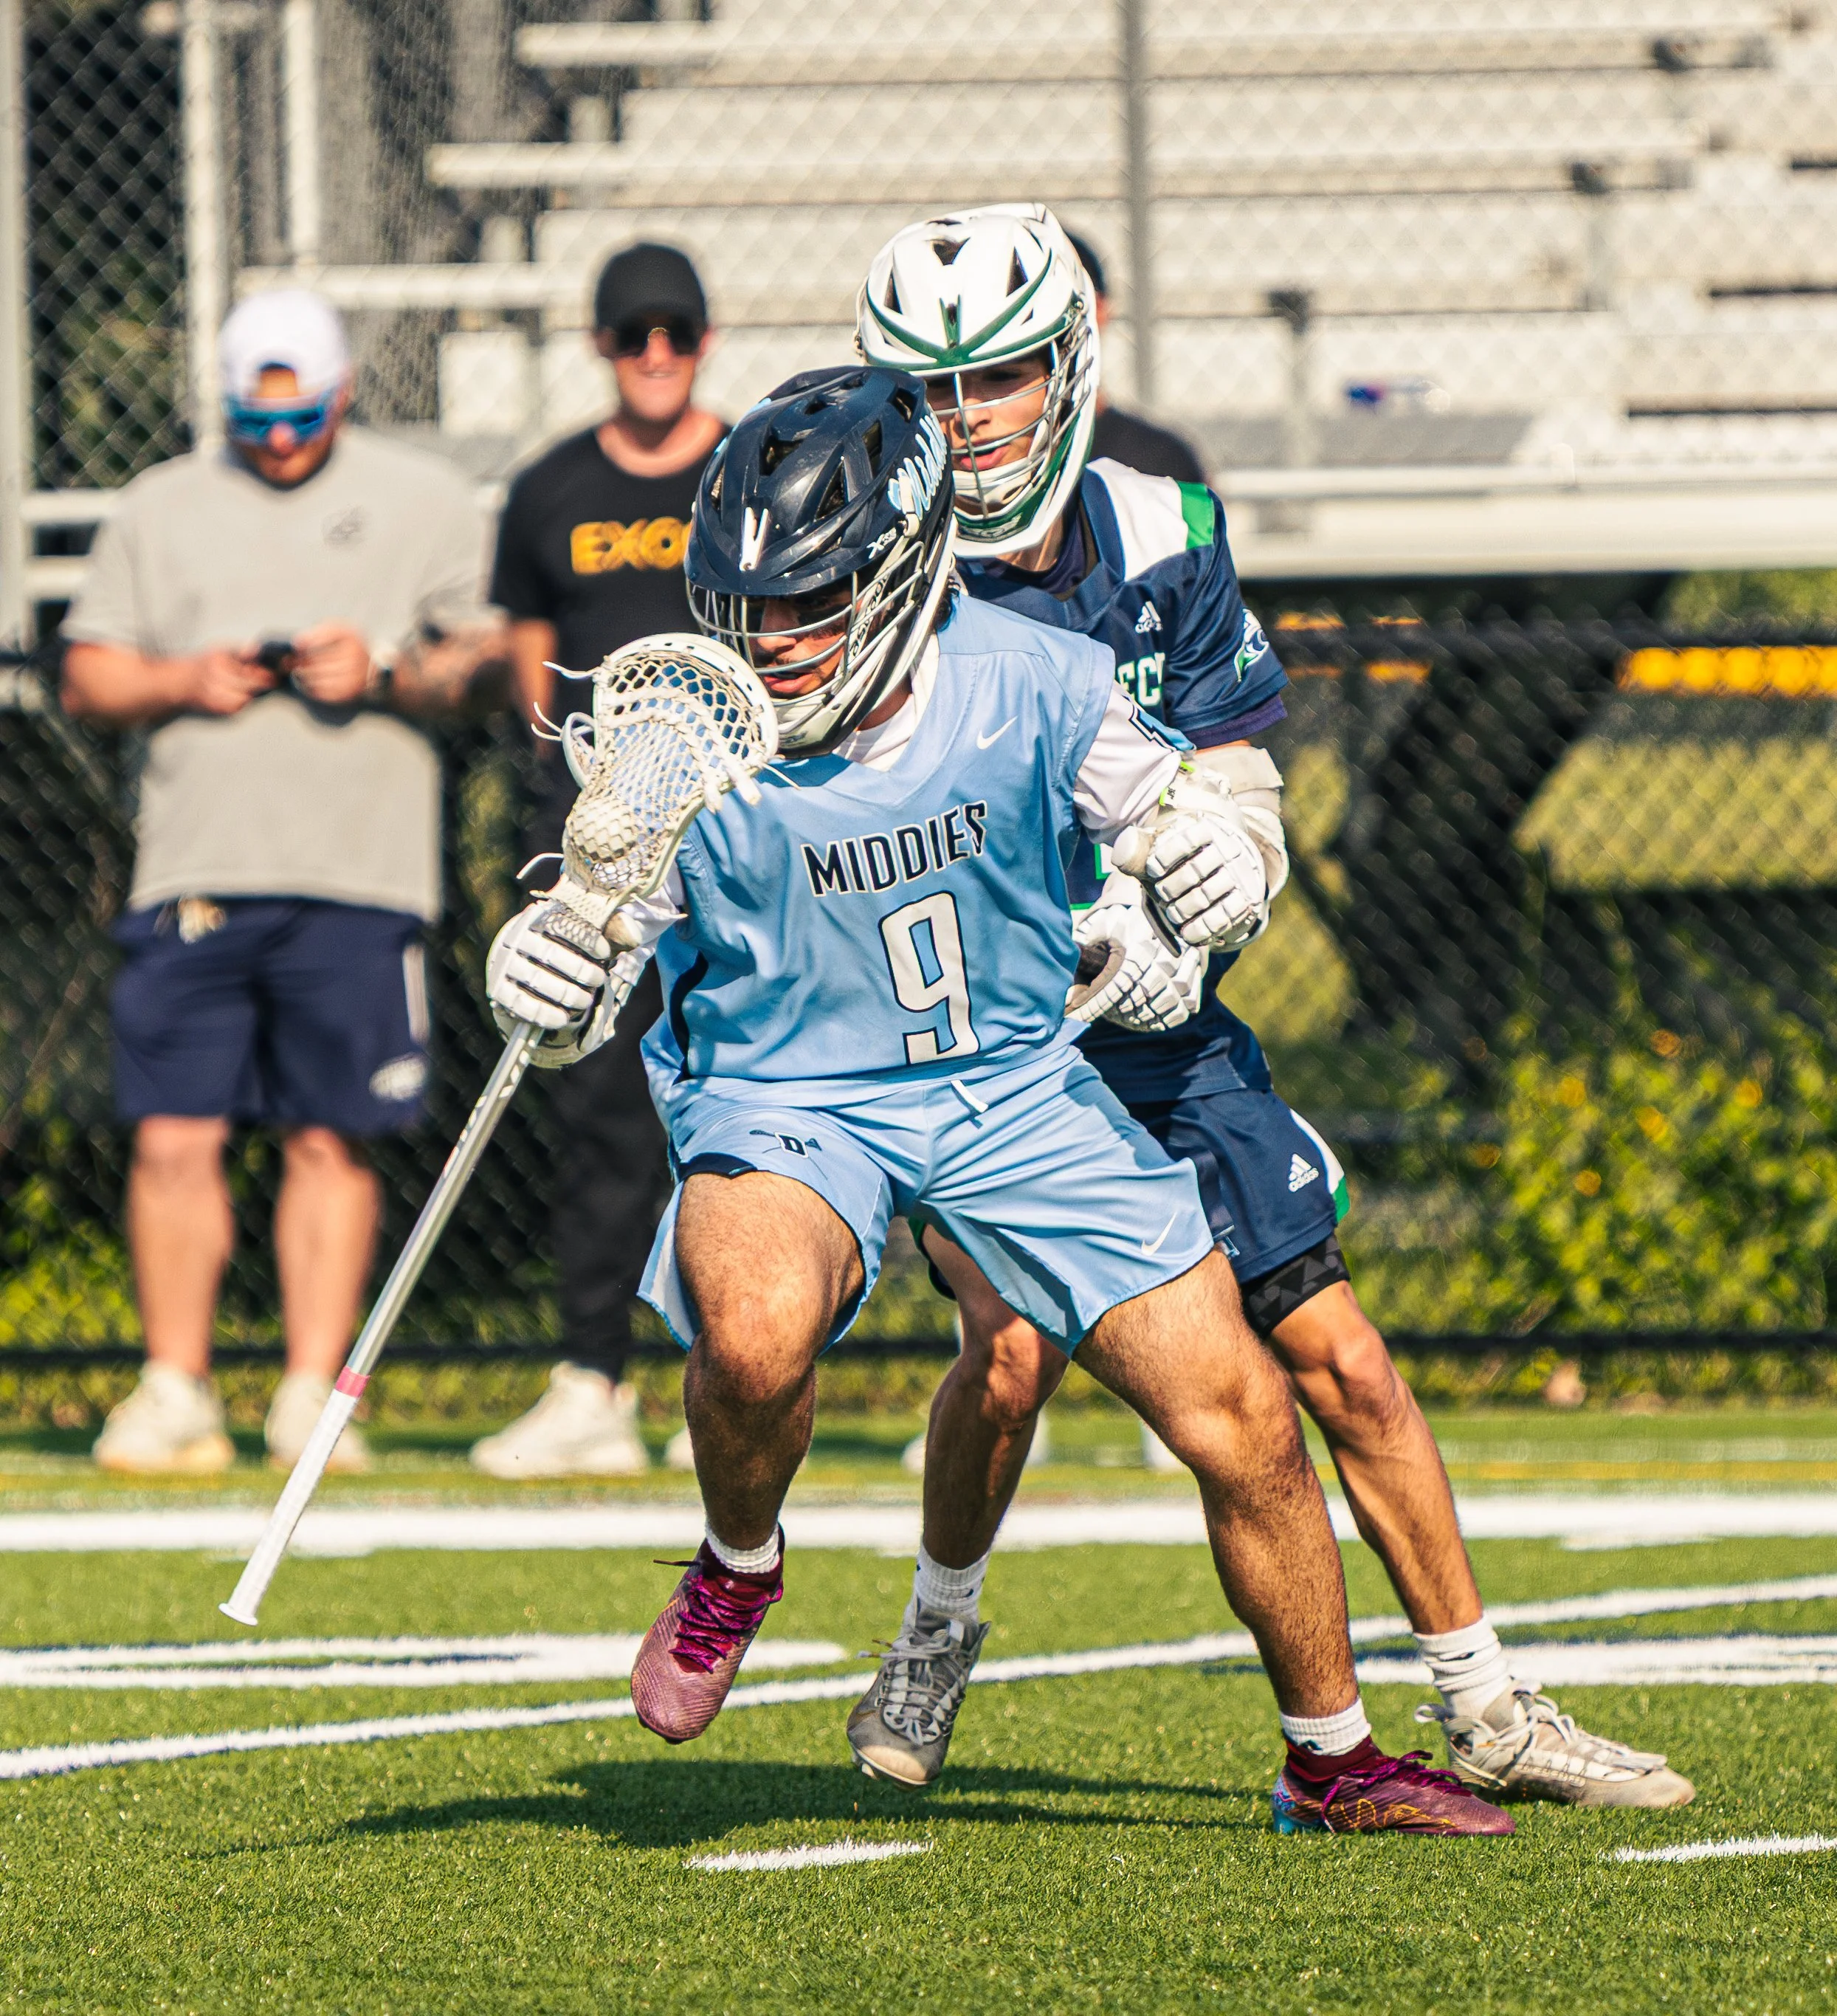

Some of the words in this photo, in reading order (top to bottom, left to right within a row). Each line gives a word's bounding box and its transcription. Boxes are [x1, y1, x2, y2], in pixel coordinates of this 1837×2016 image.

[571, 516, 692, 575] EXO
[801, 799, 988, 897] MIDDIES
[878, 890, 980, 1065] 9
[774, 1132, 809, 1158] D
